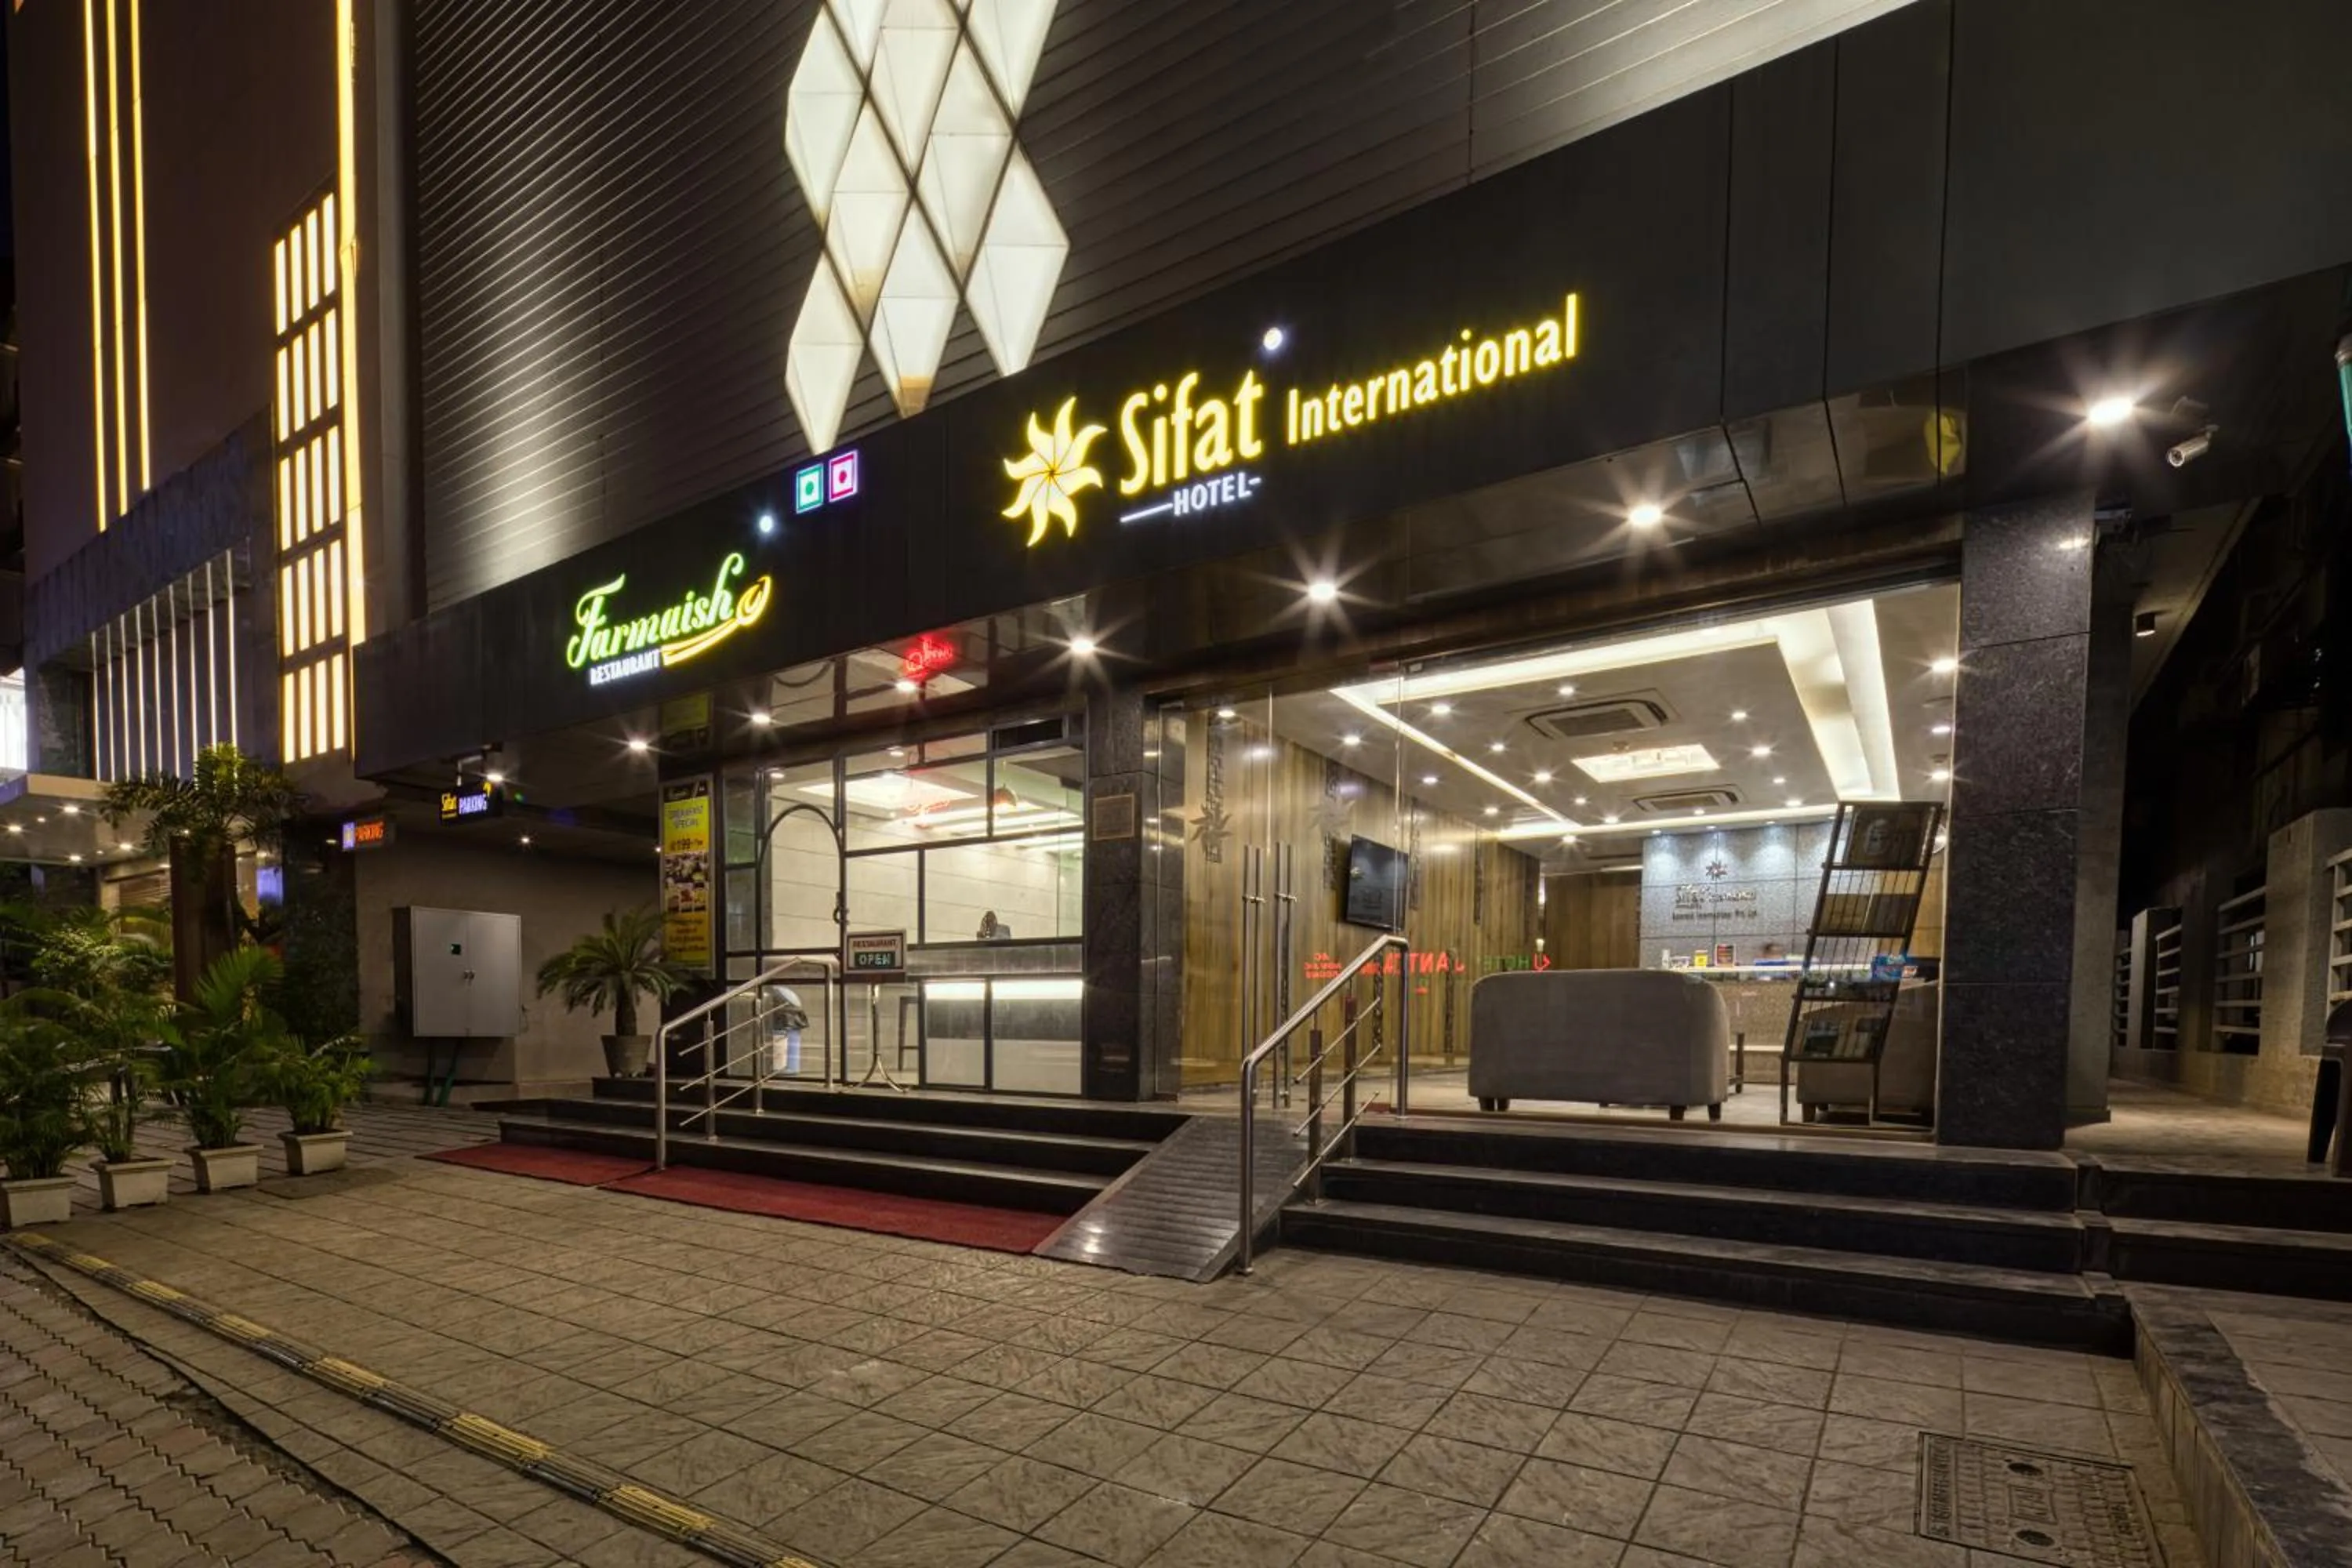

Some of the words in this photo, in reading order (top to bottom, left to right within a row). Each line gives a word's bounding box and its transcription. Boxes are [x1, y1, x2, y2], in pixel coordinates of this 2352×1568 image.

[1120, 367, 1263, 495] Sifat
[1287, 293, 1577, 446] International
[1174, 472, 1252, 516] HOTEL
[567, 552, 744, 668] Farmaish
[590, 648, 660, 686] RESTAURANT
[459, 793, 488, 815] PARKING
[852, 939, 897, 948] RESTAURANT
[858, 953, 891, 966] OPEN
